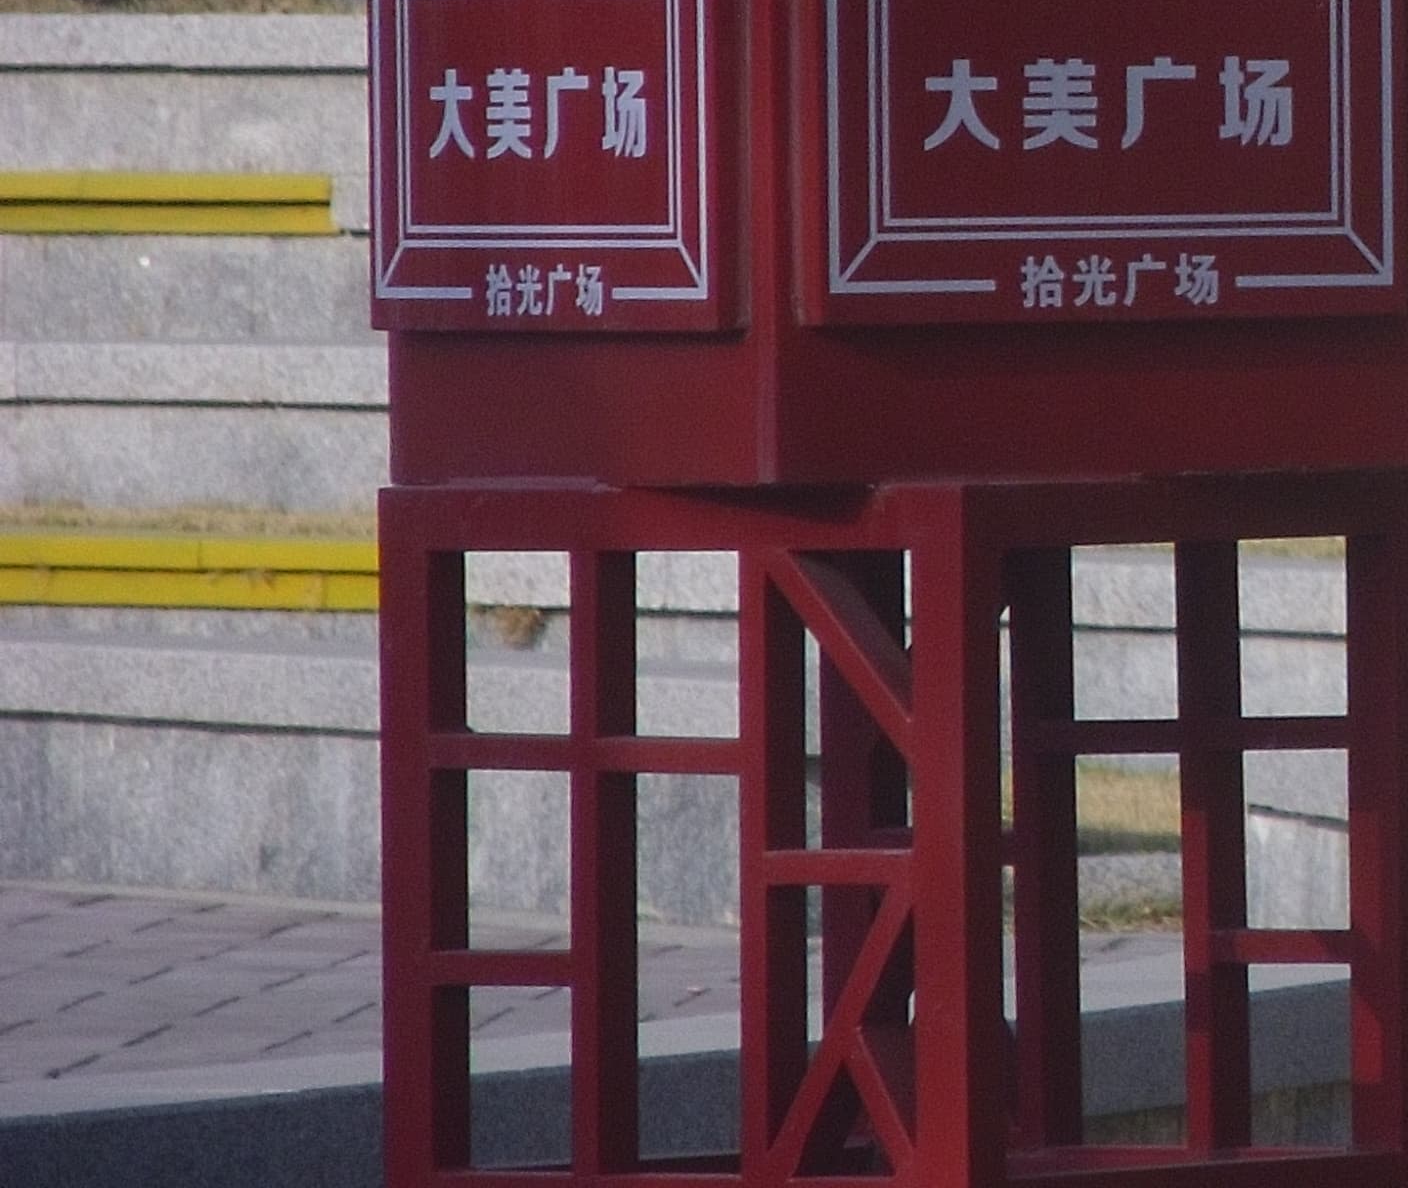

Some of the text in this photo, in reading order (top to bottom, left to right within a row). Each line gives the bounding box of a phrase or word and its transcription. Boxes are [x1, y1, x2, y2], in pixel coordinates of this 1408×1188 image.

[429, 66, 648, 159] 大美广场
[923, 55, 1294, 151] 大美广场
[485, 263, 604, 317] 拾光广场
[1020, 252, 1220, 308] 拾光广场
